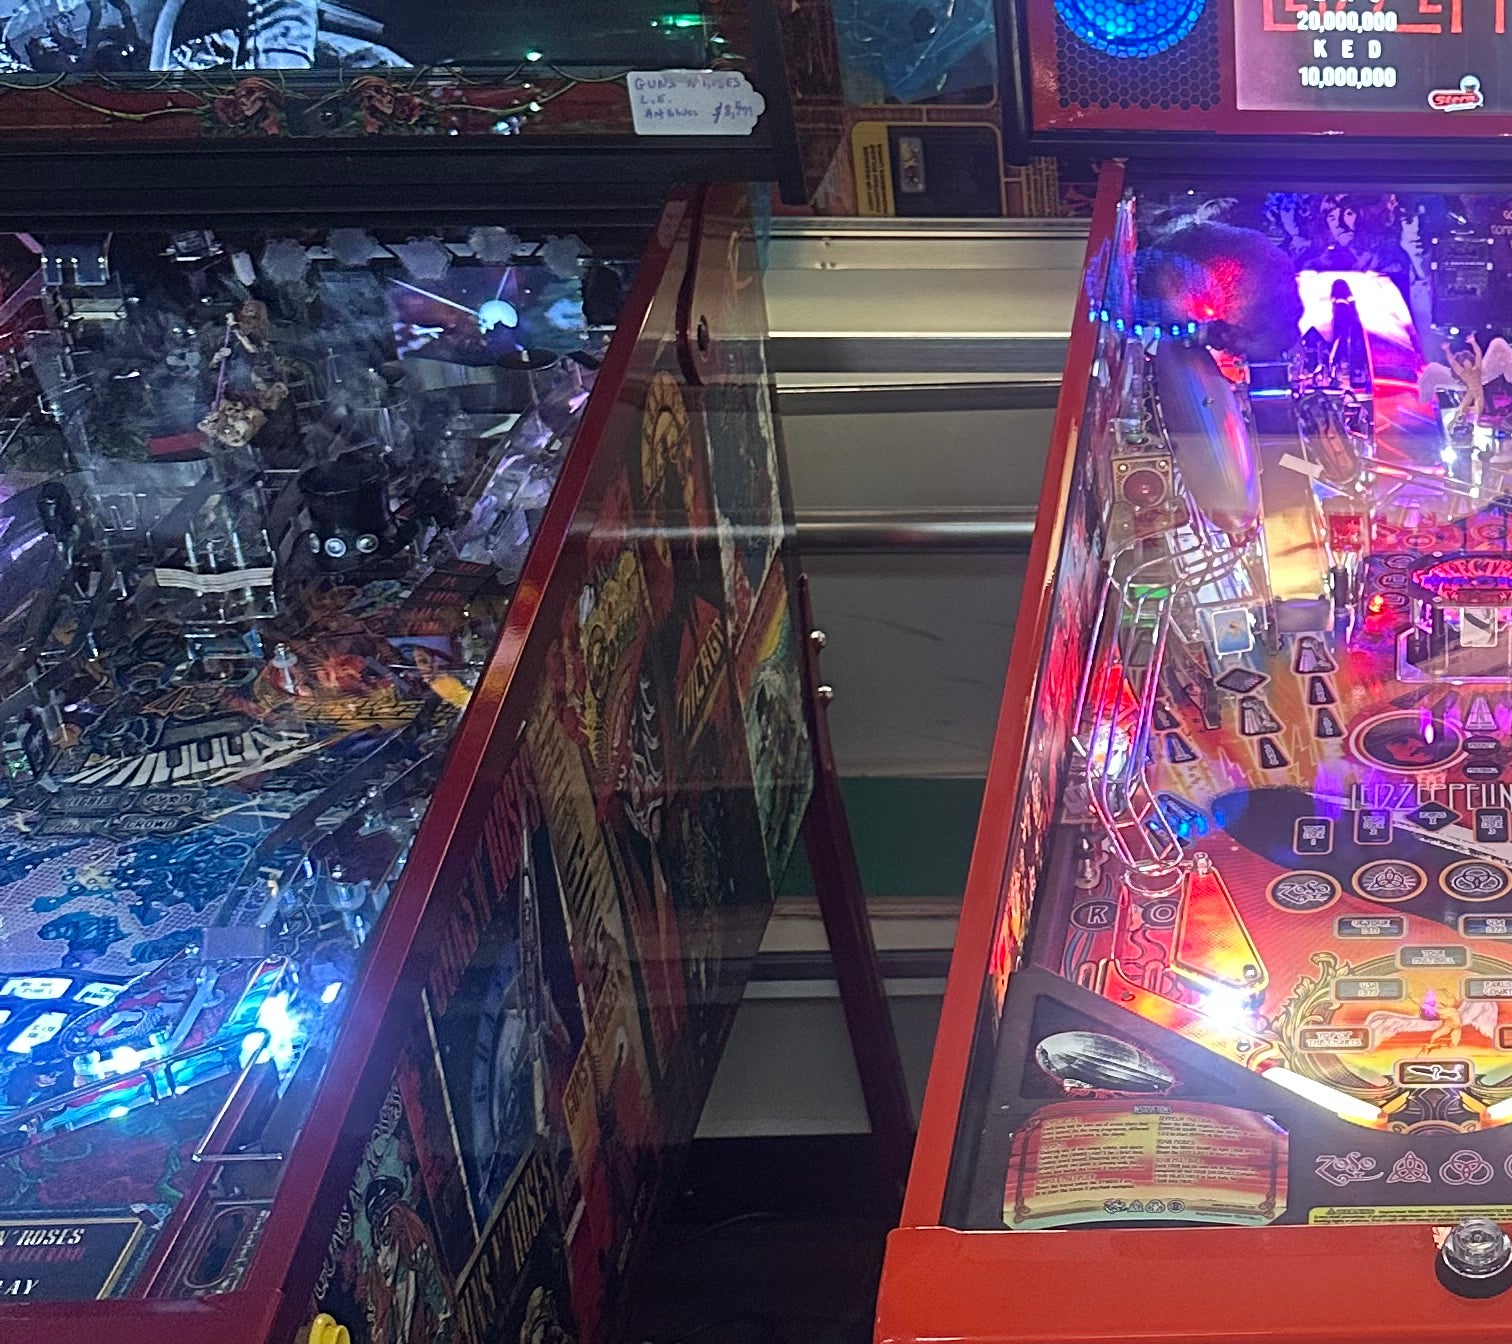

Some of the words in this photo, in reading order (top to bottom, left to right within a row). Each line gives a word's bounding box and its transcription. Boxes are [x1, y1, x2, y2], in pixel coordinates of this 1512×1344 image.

[1296, 11, 1398, 33] 20,000,000
[634, 78, 676, 90] GUNS
[1298, 66, 1397, 88] 10,000,000
[1432, 91, 1480, 106] Stern
[16, 1228, 86, 1246] ROSES
